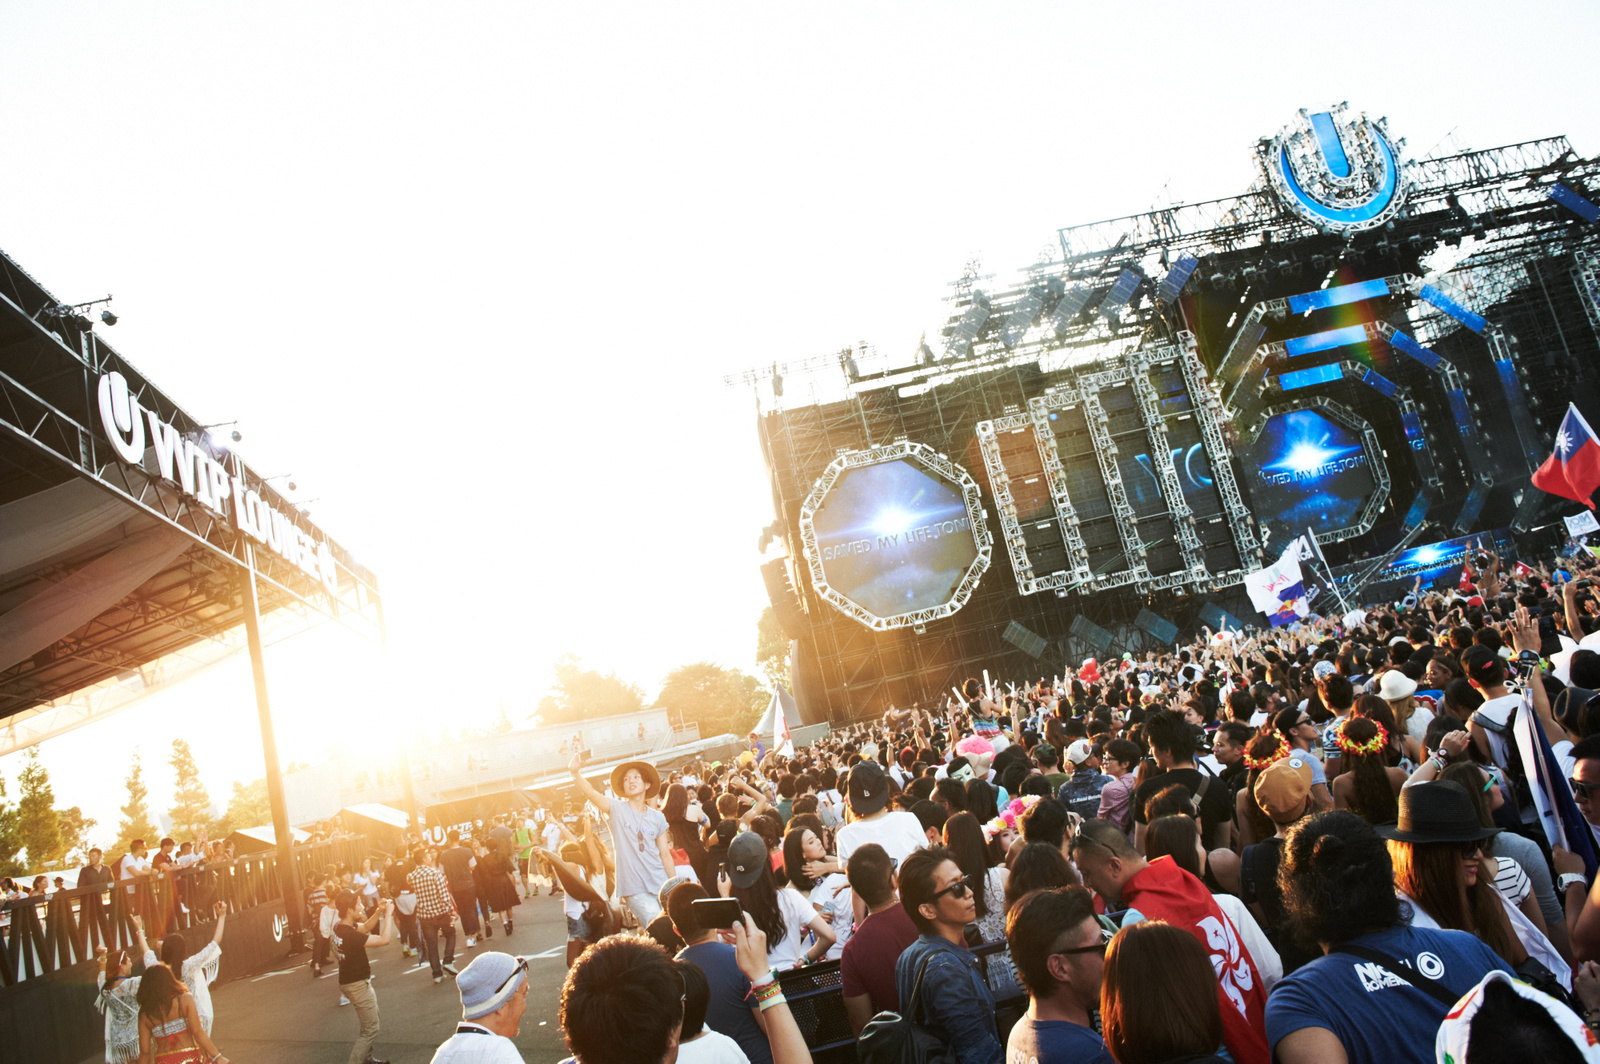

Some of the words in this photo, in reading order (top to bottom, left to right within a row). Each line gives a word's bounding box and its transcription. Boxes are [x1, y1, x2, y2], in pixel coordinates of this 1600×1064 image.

[1295, 467, 1313, 482] MY
[1317, 460, 1338, 477] LIFE
[824, 540, 871, 560] SAVED
[878, 533, 899, 551] MY
[905, 524, 932, 545] LIFE
